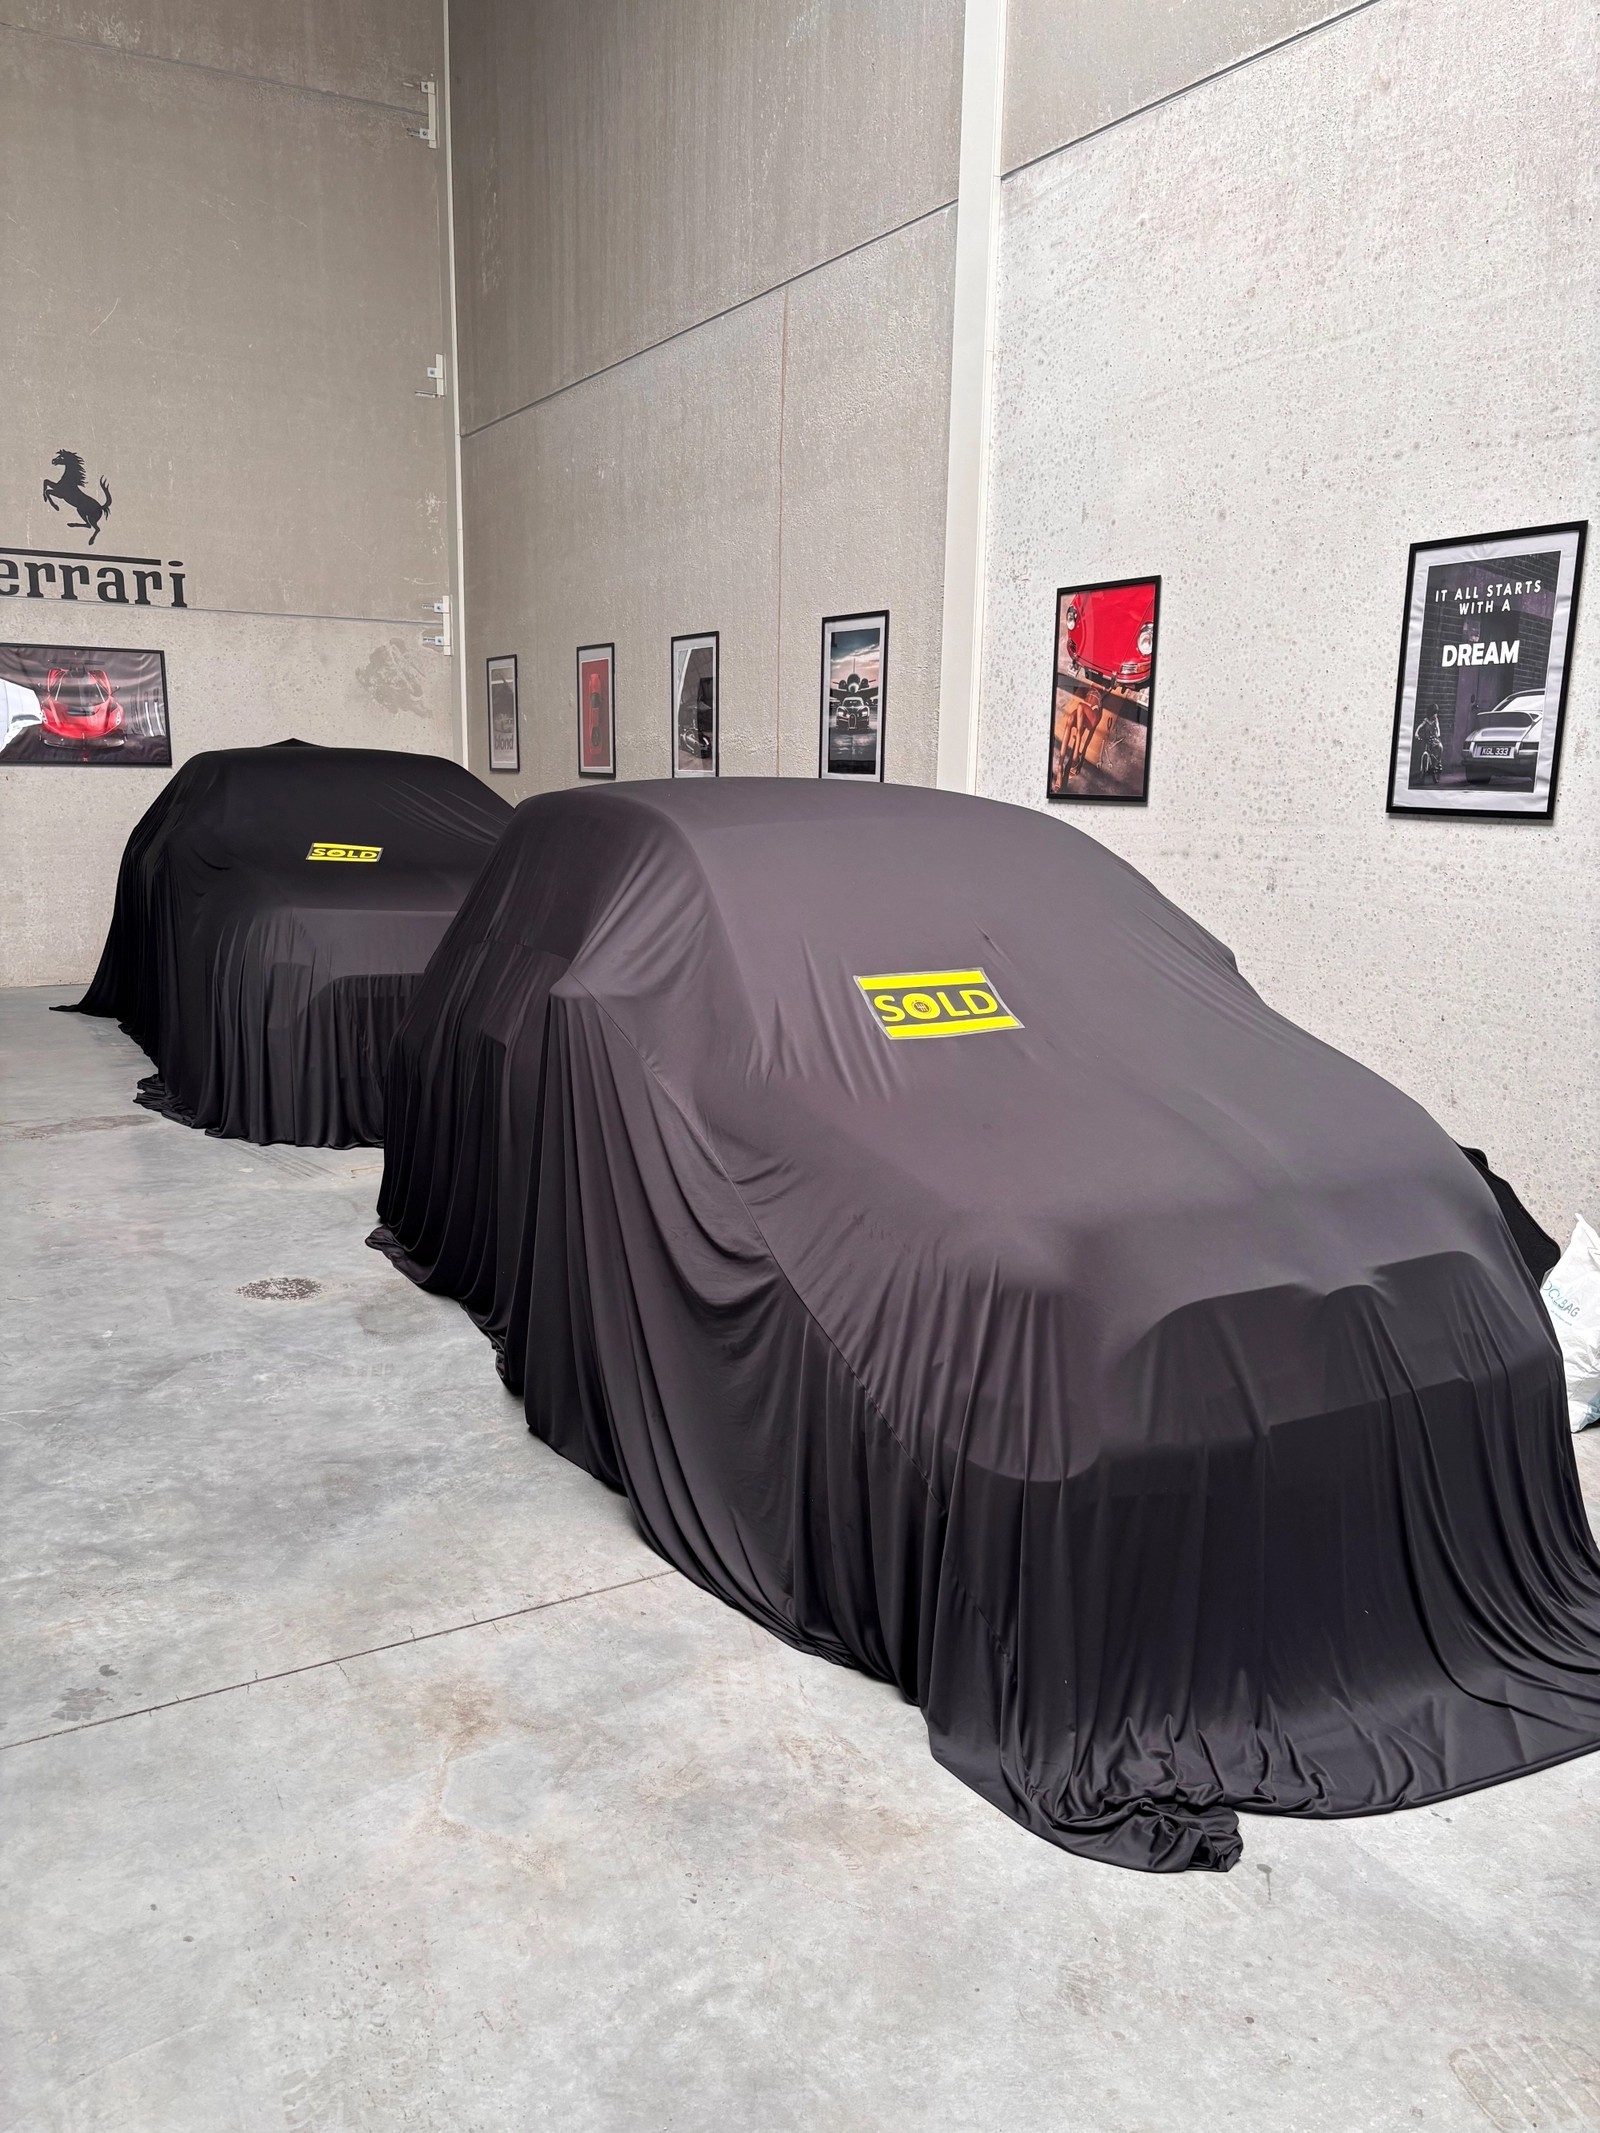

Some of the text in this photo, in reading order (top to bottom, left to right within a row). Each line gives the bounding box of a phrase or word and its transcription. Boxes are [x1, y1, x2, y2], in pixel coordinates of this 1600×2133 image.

[0, 555, 187, 608] errari
[1435, 580, 1541, 602] IT ALL STARTS
[1459, 599, 1511, 615] WITH A
[1442, 640, 1520, 667] DREAM
[312, 848, 377, 858] SOLD
[873, 990, 998, 1022] SOLD
